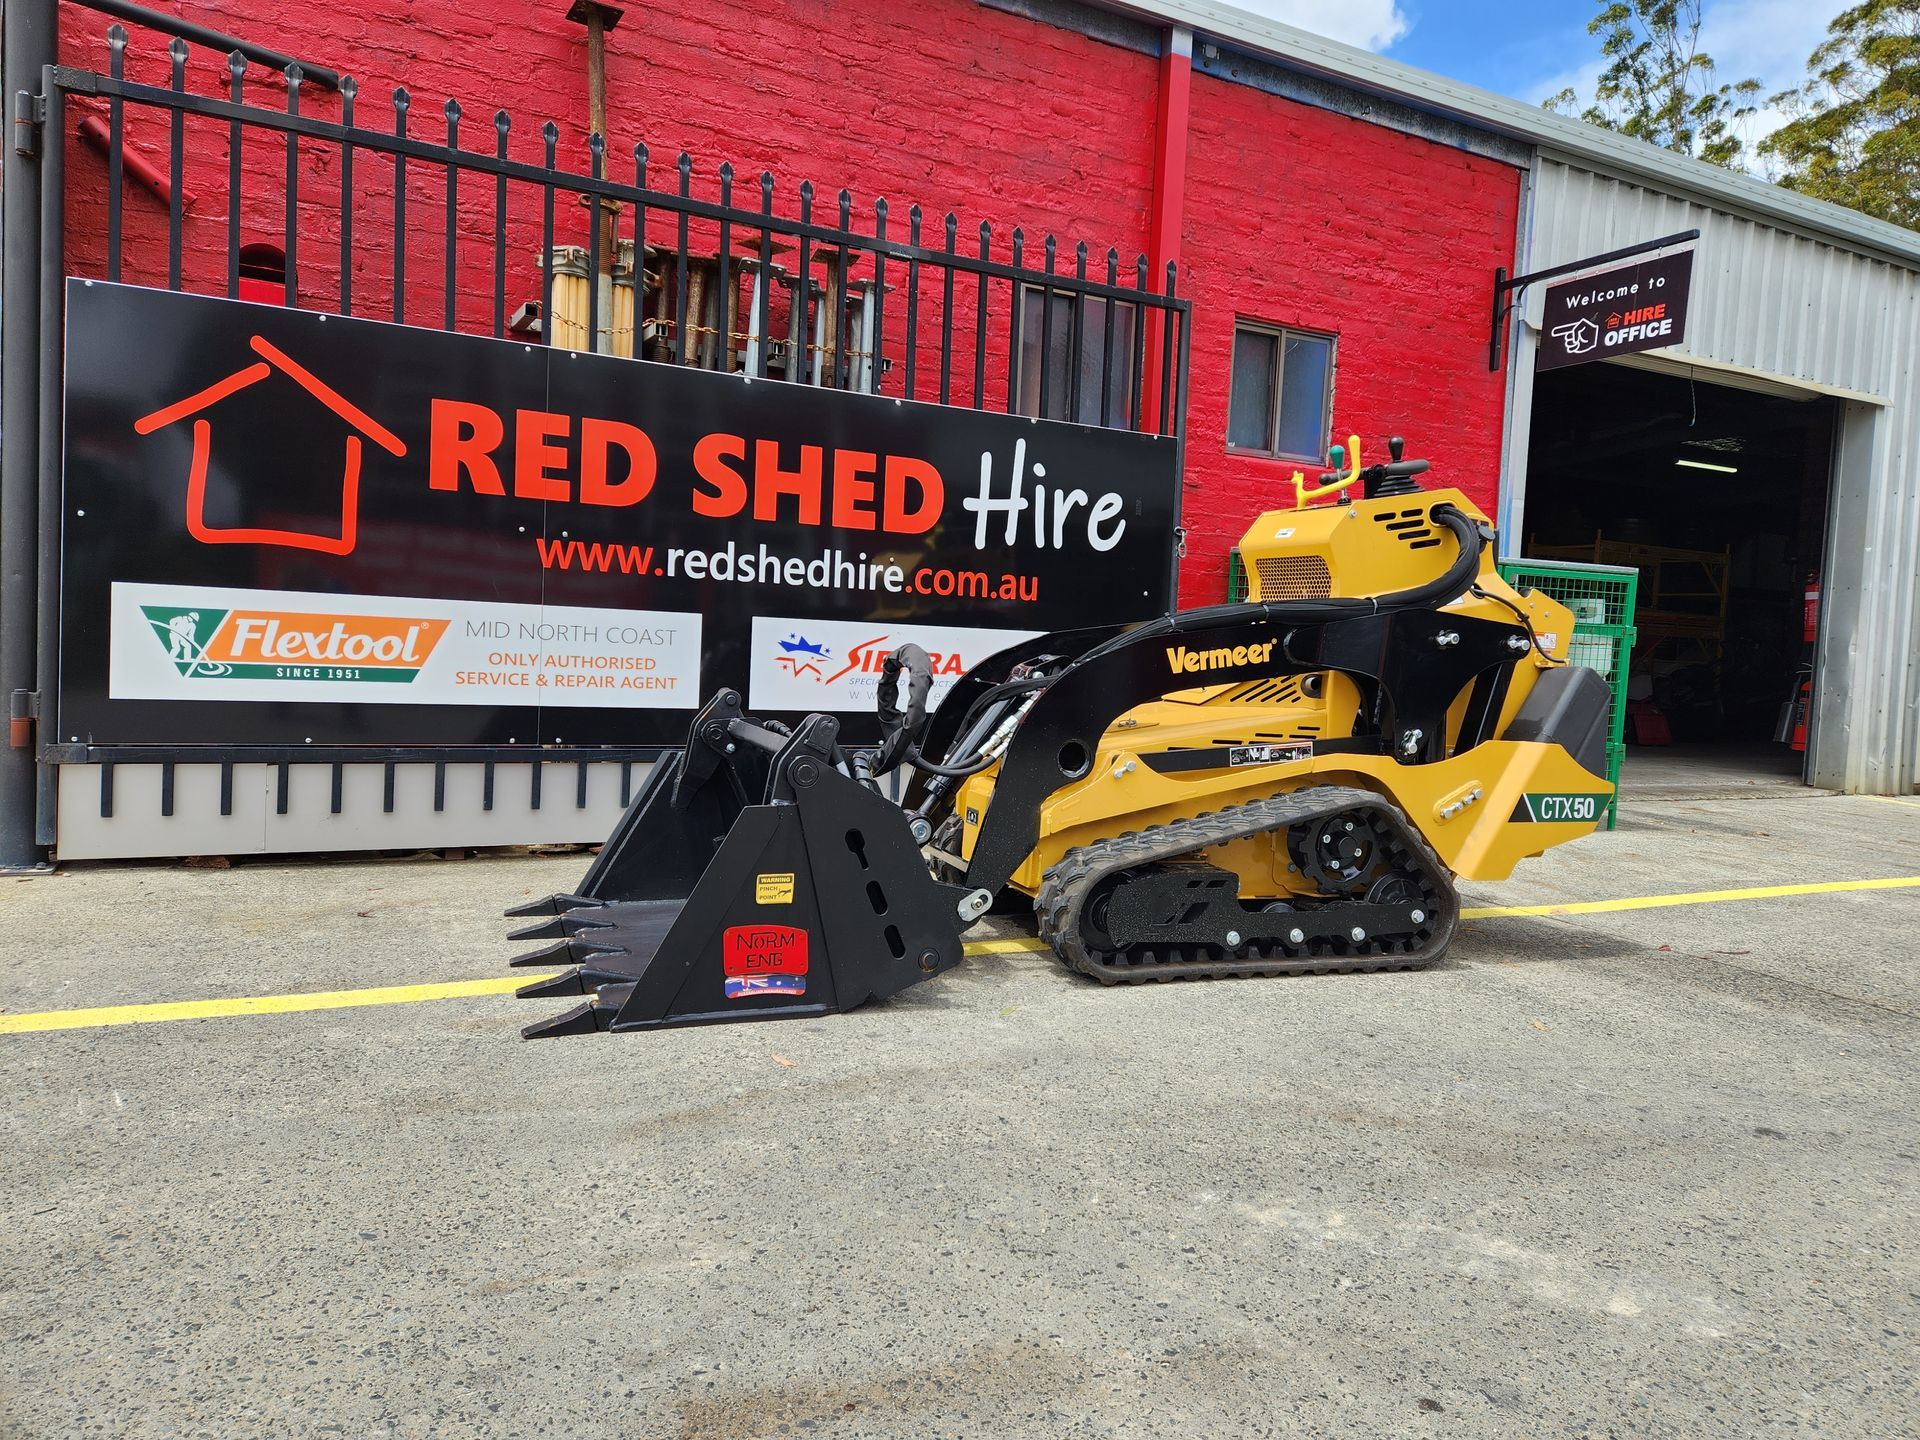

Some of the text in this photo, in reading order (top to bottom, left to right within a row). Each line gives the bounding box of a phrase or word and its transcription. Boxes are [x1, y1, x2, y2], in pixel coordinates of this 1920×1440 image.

[1565, 276, 1666, 309] Welcome to
[1623, 303, 1666, 326] HIRE
[1604, 318, 1673, 347] OFFICE
[429, 398, 1126, 552] RED SHED Hire
[536, 537, 1039, 602] www.redshedhire.com.au
[230, 618, 420, 663] Flextool
[466, 619, 678, 646] MID NORTH COAST
[488, 651, 657, 670] ONLY AUTHORISED
[1165, 642, 1273, 674] Vermeer
[276, 667, 361, 680] SINCE 1951
[455, 671, 677, 690] SERVICE & REPAIR AGENT
[1541, 796, 1595, 820] CTX50
[760, 876, 791, 884] WARNING
[746, 952, 783, 969] ENG
